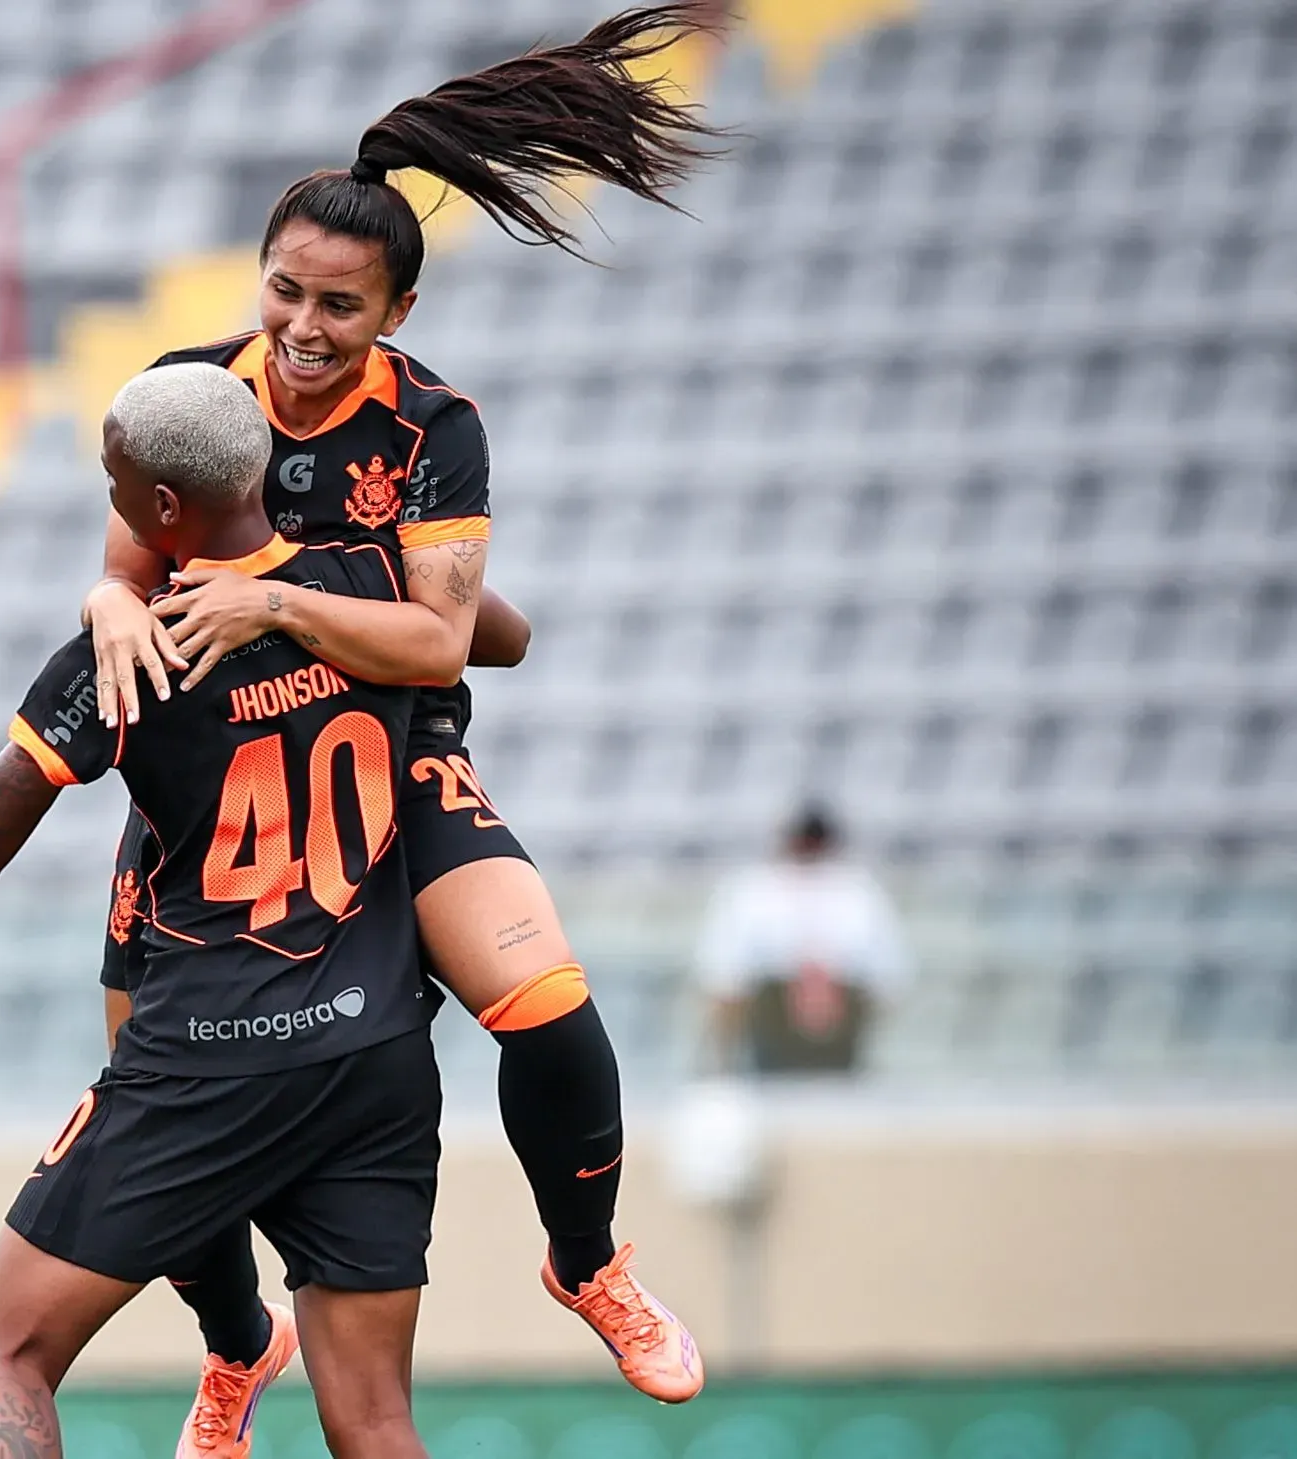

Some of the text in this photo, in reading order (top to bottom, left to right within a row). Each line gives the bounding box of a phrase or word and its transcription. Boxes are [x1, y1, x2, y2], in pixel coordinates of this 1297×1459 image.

[279, 454, 315, 493] G
[54, 675, 98, 731] bm
[63, 669, 89, 699] banco
[228, 662, 350, 724] JHONSON
[410, 754, 505, 825] 20
[202, 710, 394, 932] 40
[187, 1001, 335, 1041] tecnogera
